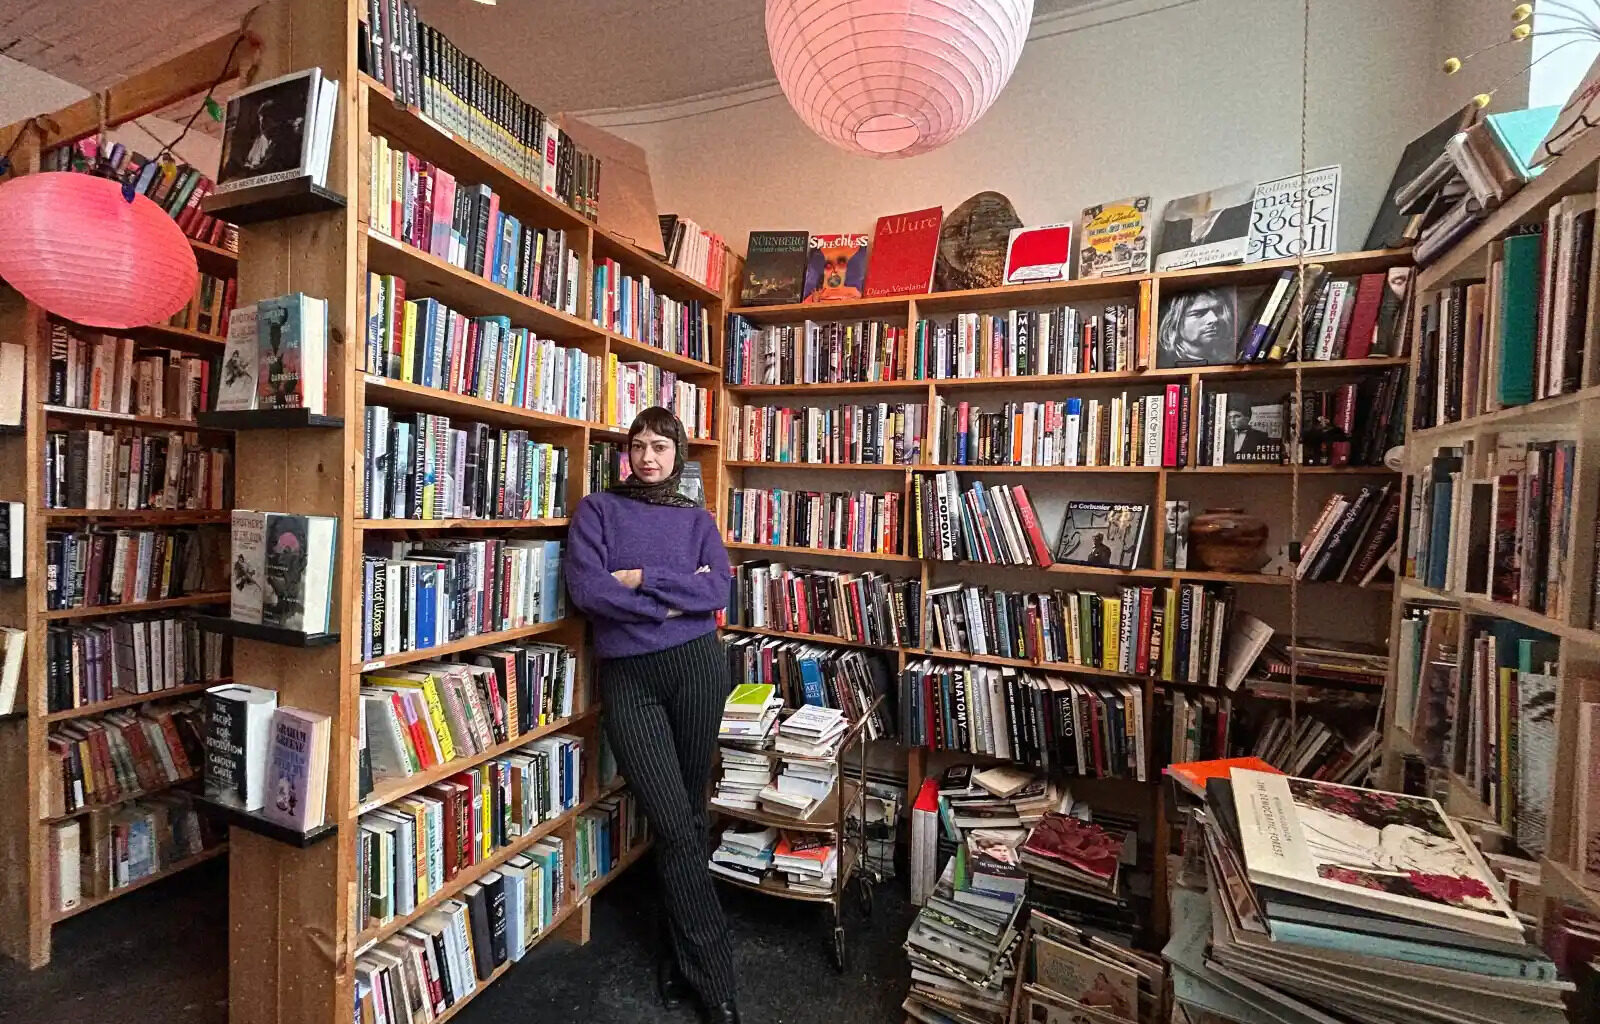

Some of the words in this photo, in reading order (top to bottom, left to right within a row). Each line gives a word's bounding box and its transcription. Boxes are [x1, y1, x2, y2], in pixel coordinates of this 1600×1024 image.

[879, 216, 939, 236] Allure
[751, 235, 804, 246] NÜRNBERG
[1260, 223, 1327, 259] Roll
[1328, 289, 1341, 324] GLORY
[1018, 316, 1028, 354] MARR
[1105, 324, 1114, 351] MUSIC
[1322, 326, 1334, 353] DAYS
[1150, 396, 1159, 422] ROCK
[416, 437, 425, 472] TRUMAN
[1148, 432, 1158, 456] ROLL
[1236, 452, 1280, 460] GURALNICK
[415, 473, 424, 506] CAPOTE
[1079, 502, 1111, 512] Corbusier
[940, 496, 950, 549] POPOVA
[374, 568, 386, 592] World
[372, 601, 384, 637] Wonders
[1180, 588, 1191, 630] SCOTLAND
[216, 703, 227, 713] THE
[954, 673, 967, 729] ANATOMY
[212, 714, 233, 727] RECIPE
[1062, 697, 1073, 736] MEXICO
[206, 736, 243, 755] REVOLUTION
[209, 753, 237, 770] CAROLYN
[212, 766, 233, 780] CHUTE
[1269, 832, 1284, 857] FOREST
